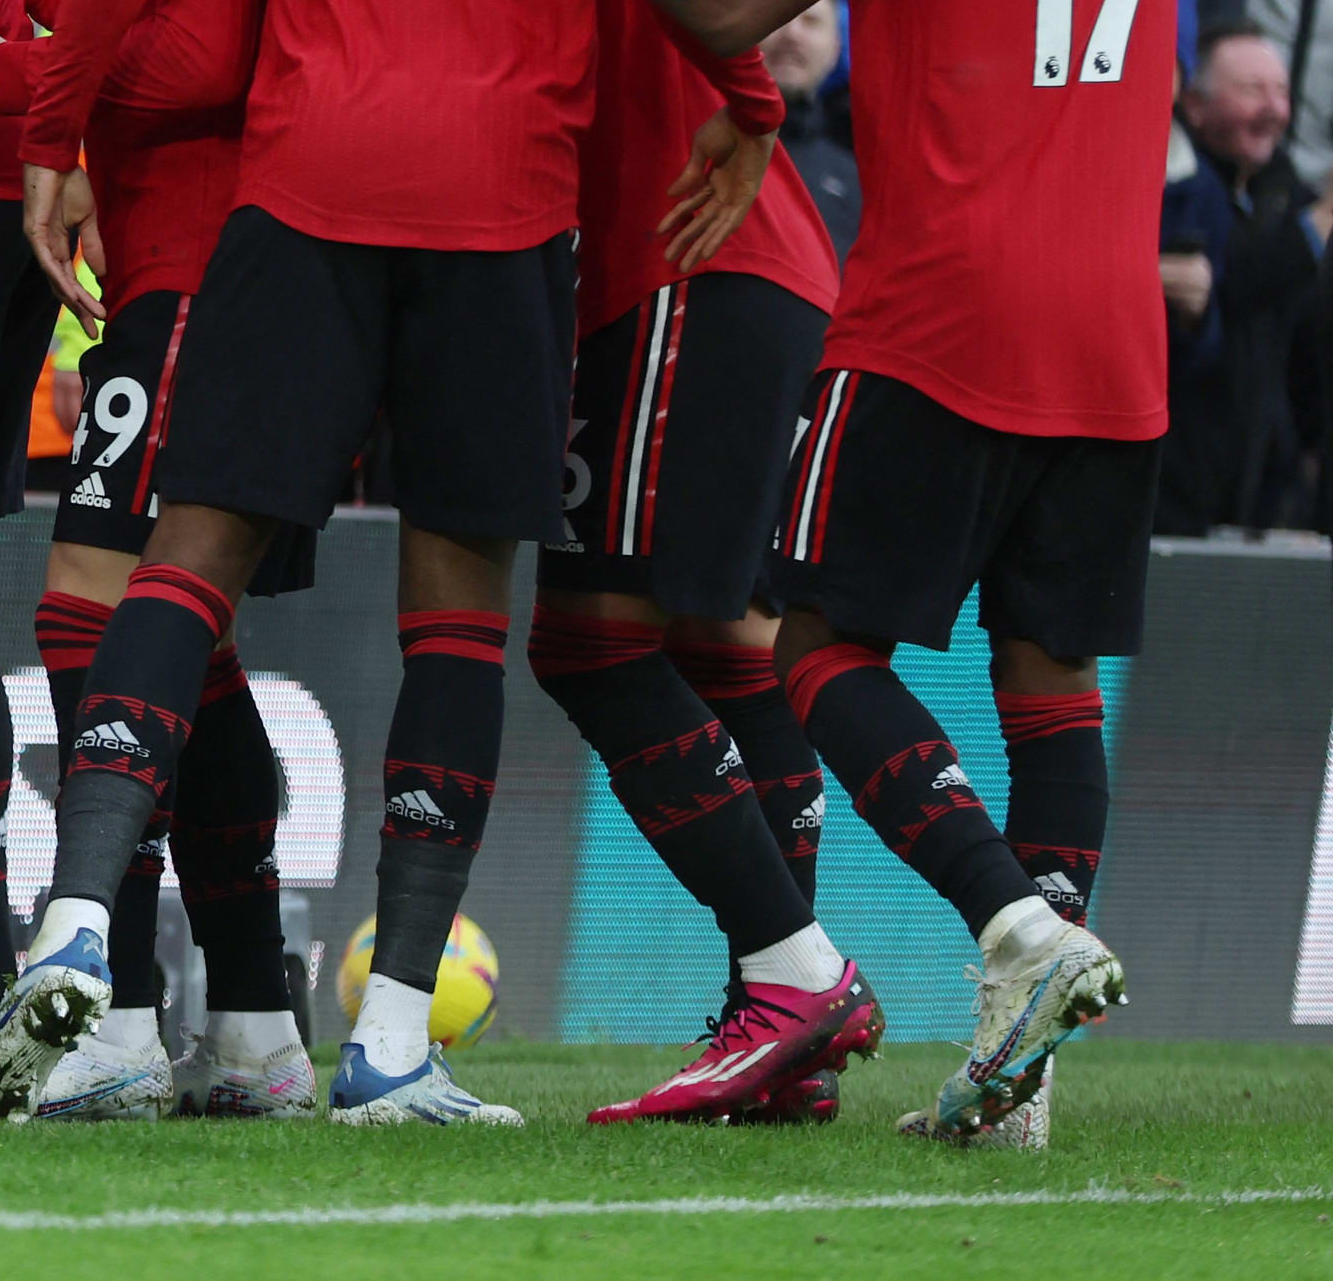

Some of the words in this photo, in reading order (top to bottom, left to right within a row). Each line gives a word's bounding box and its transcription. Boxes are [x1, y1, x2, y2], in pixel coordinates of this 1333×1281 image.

[70, 492, 112, 509] adidas
[74, 736, 152, 758] adidas
[386, 802, 457, 831] adidas
